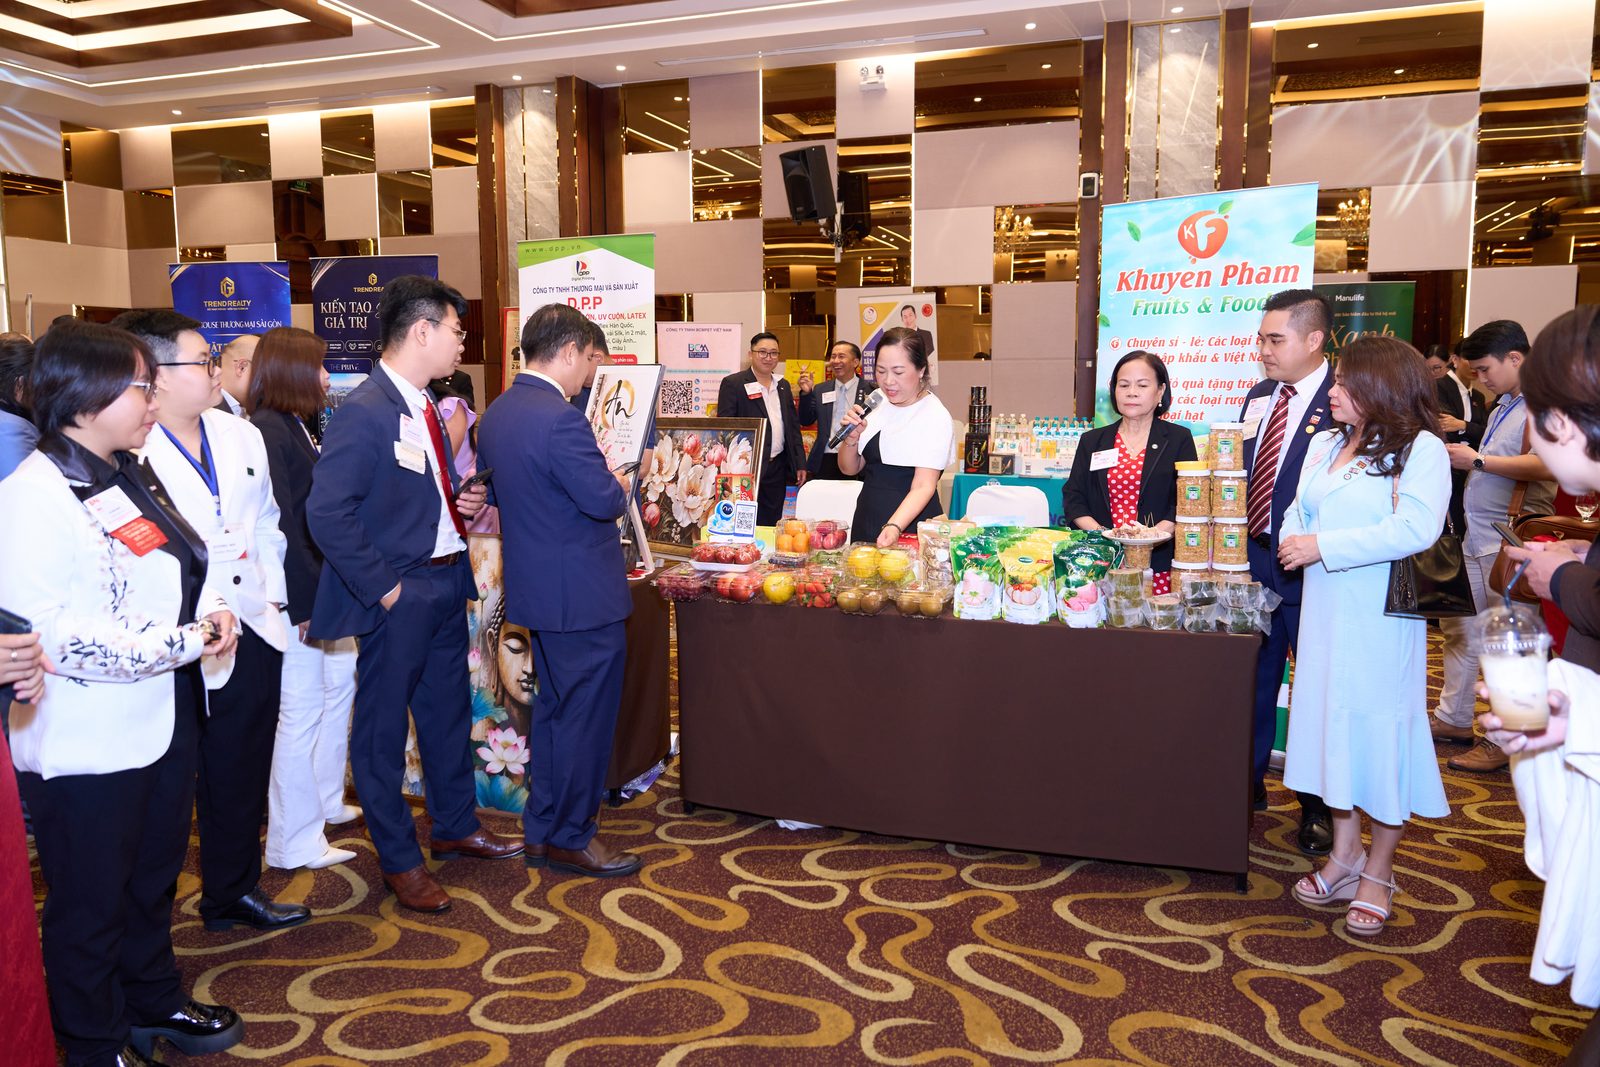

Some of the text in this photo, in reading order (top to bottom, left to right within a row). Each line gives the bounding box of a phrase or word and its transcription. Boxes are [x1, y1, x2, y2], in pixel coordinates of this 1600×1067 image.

[1116, 261, 1300, 294] Khuyen Pham
[532, 285, 547, 294] CÔNG
[594, 285, 605, 293] MẠI
[605, 283, 612, 291] VÀ
[613, 282, 624, 291] SẢN
[624, 280, 639, 290] XUẤT
[568, 296, 603, 310] D.P.P
[1335, 294, 1365, 302] Manulife
[320, 298, 346, 314] KIẾN
[349, 301, 372, 315] TẠO
[1132, 295, 1190, 316] Fruits
[1197, 296, 1213, 314] &
[324, 314, 368, 330] GIÁ TRỊ
[627, 312, 647, 320] LATEX
[201, 321, 218, 329] OUSE
[256, 318, 267, 328] SÀI
[267, 319, 282, 328] GÒN
[1127, 337, 1166, 350] Chuyên
[1208, 335, 1228, 347] Các
[1230, 335, 1253, 348] loại
[1178, 350, 1207, 363] khẩu
[1211, 352, 1220, 363] &
[1224, 351, 1245, 364] Việt
[1248, 351, 1264, 362] Na
[329, 363, 339, 371] THE
[1182, 378, 1204, 391] quà
[1208, 378, 1234, 391] tặng
[1177, 394, 1197, 405] các
[1199, 394, 1222, 407] loại
[1224, 396, 1246, 407] rượ
[1184, 410, 1205, 422] hạt
